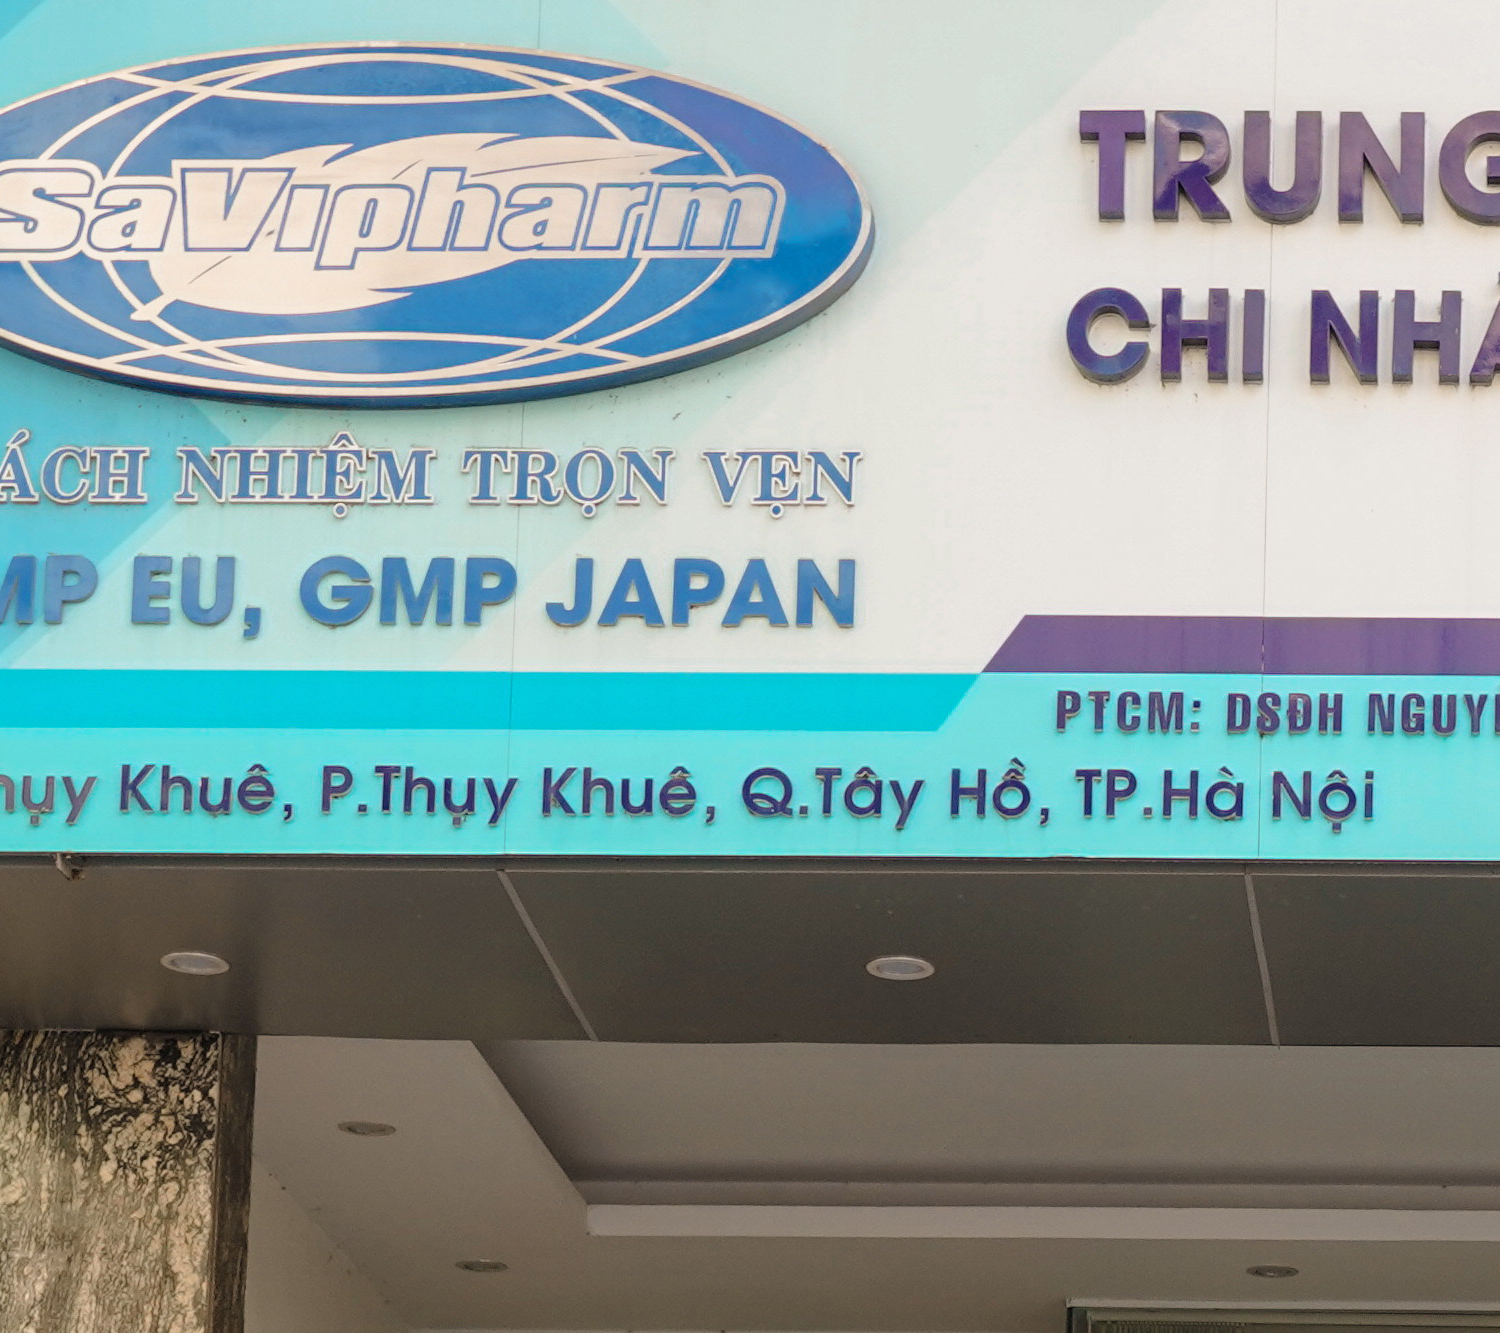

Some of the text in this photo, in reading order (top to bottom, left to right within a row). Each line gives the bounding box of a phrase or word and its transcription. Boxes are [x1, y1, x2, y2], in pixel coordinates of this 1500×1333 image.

[1065, 286, 1264, 386] CHI
[175, 430, 436, 518] NHIỆM
[462, 447, 676, 518] TRỌN
[704, 448, 863, 519] VẸN
[130, 554, 263, 640] EU,
[299, 557, 517, 627] GMP
[545, 557, 856, 629] JAPAN
[1055, 689, 1202, 735] PTCM:
[1226, 690, 1344, 737] DSĐH
[120, 763, 294, 823] Khuê,
[320, 765, 519, 827] P.Thụy
[542, 765, 717, 826] Khuê,
[742, 767, 924, 830] Q.Tây
[950, 757, 1050, 826] Hồ,
[1075, 766, 1246, 822] TP.Hà
[1272, 769, 1375, 834] Nội
